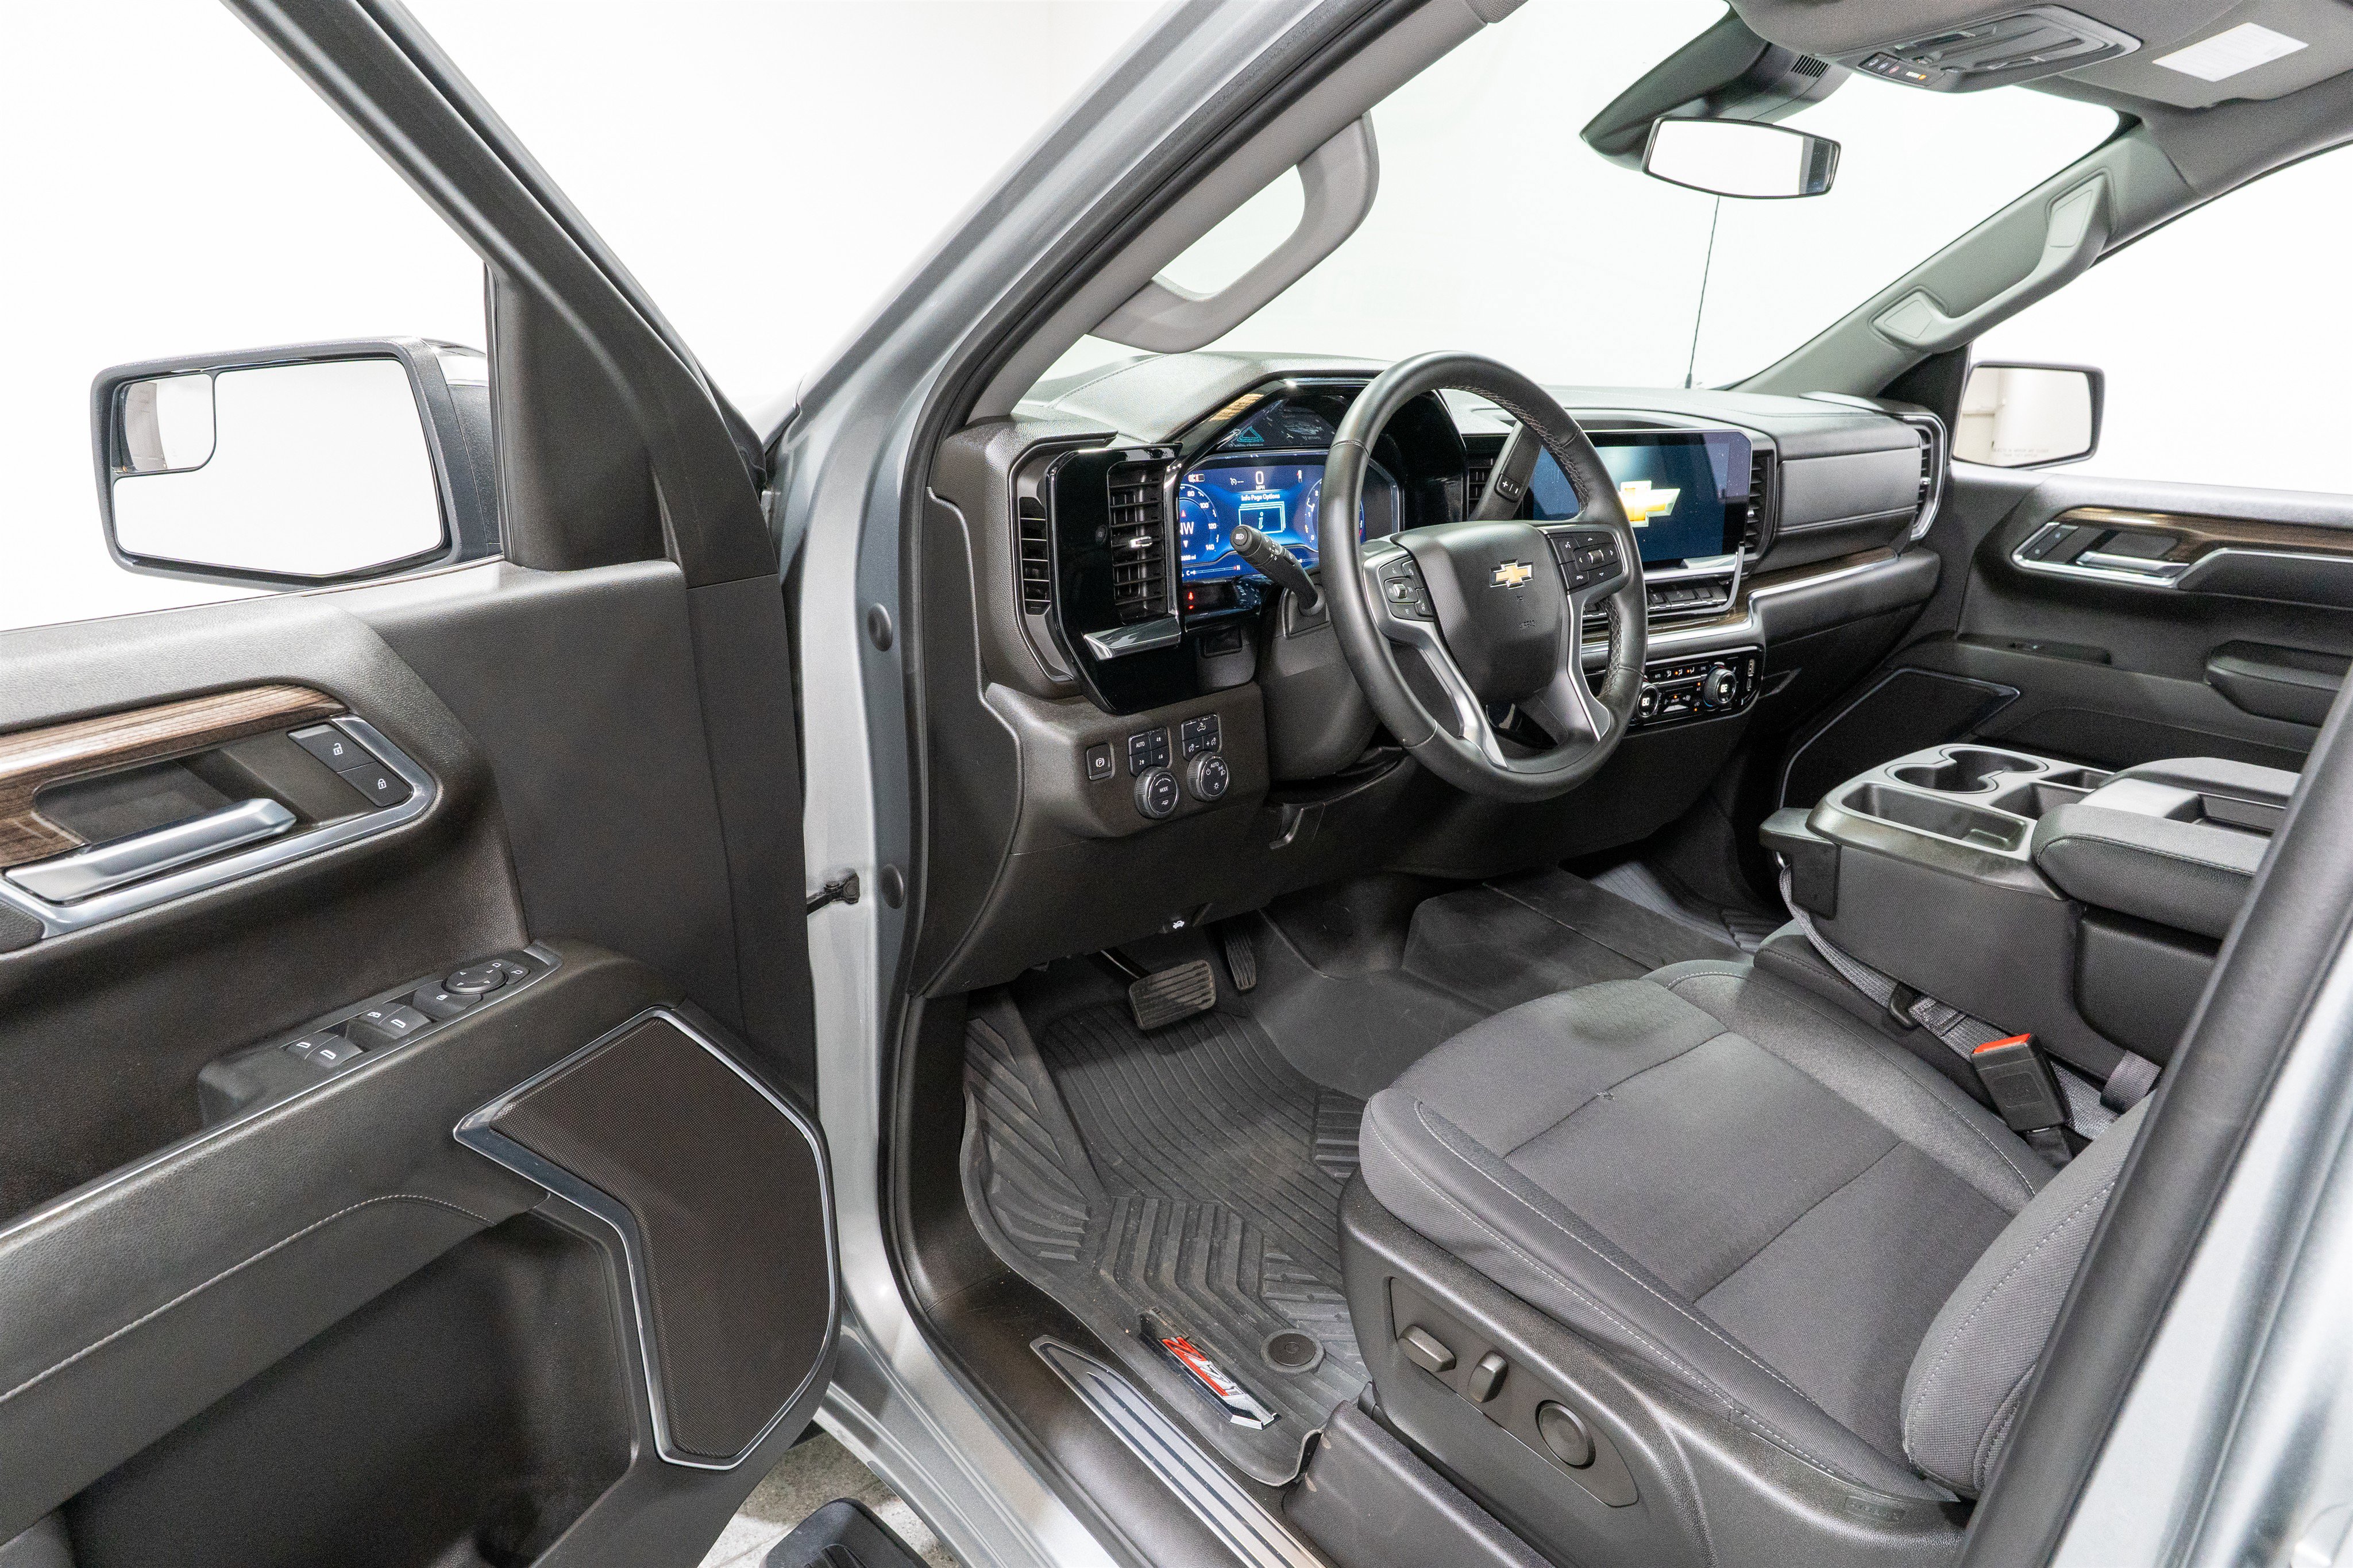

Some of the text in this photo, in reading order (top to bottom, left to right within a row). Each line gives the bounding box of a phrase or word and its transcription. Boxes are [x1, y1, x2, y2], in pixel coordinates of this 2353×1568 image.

[1255, 471, 1264, 485] 0
[1251, 494, 1263, 502] Page
[1642, 697, 1650, 706] 80
